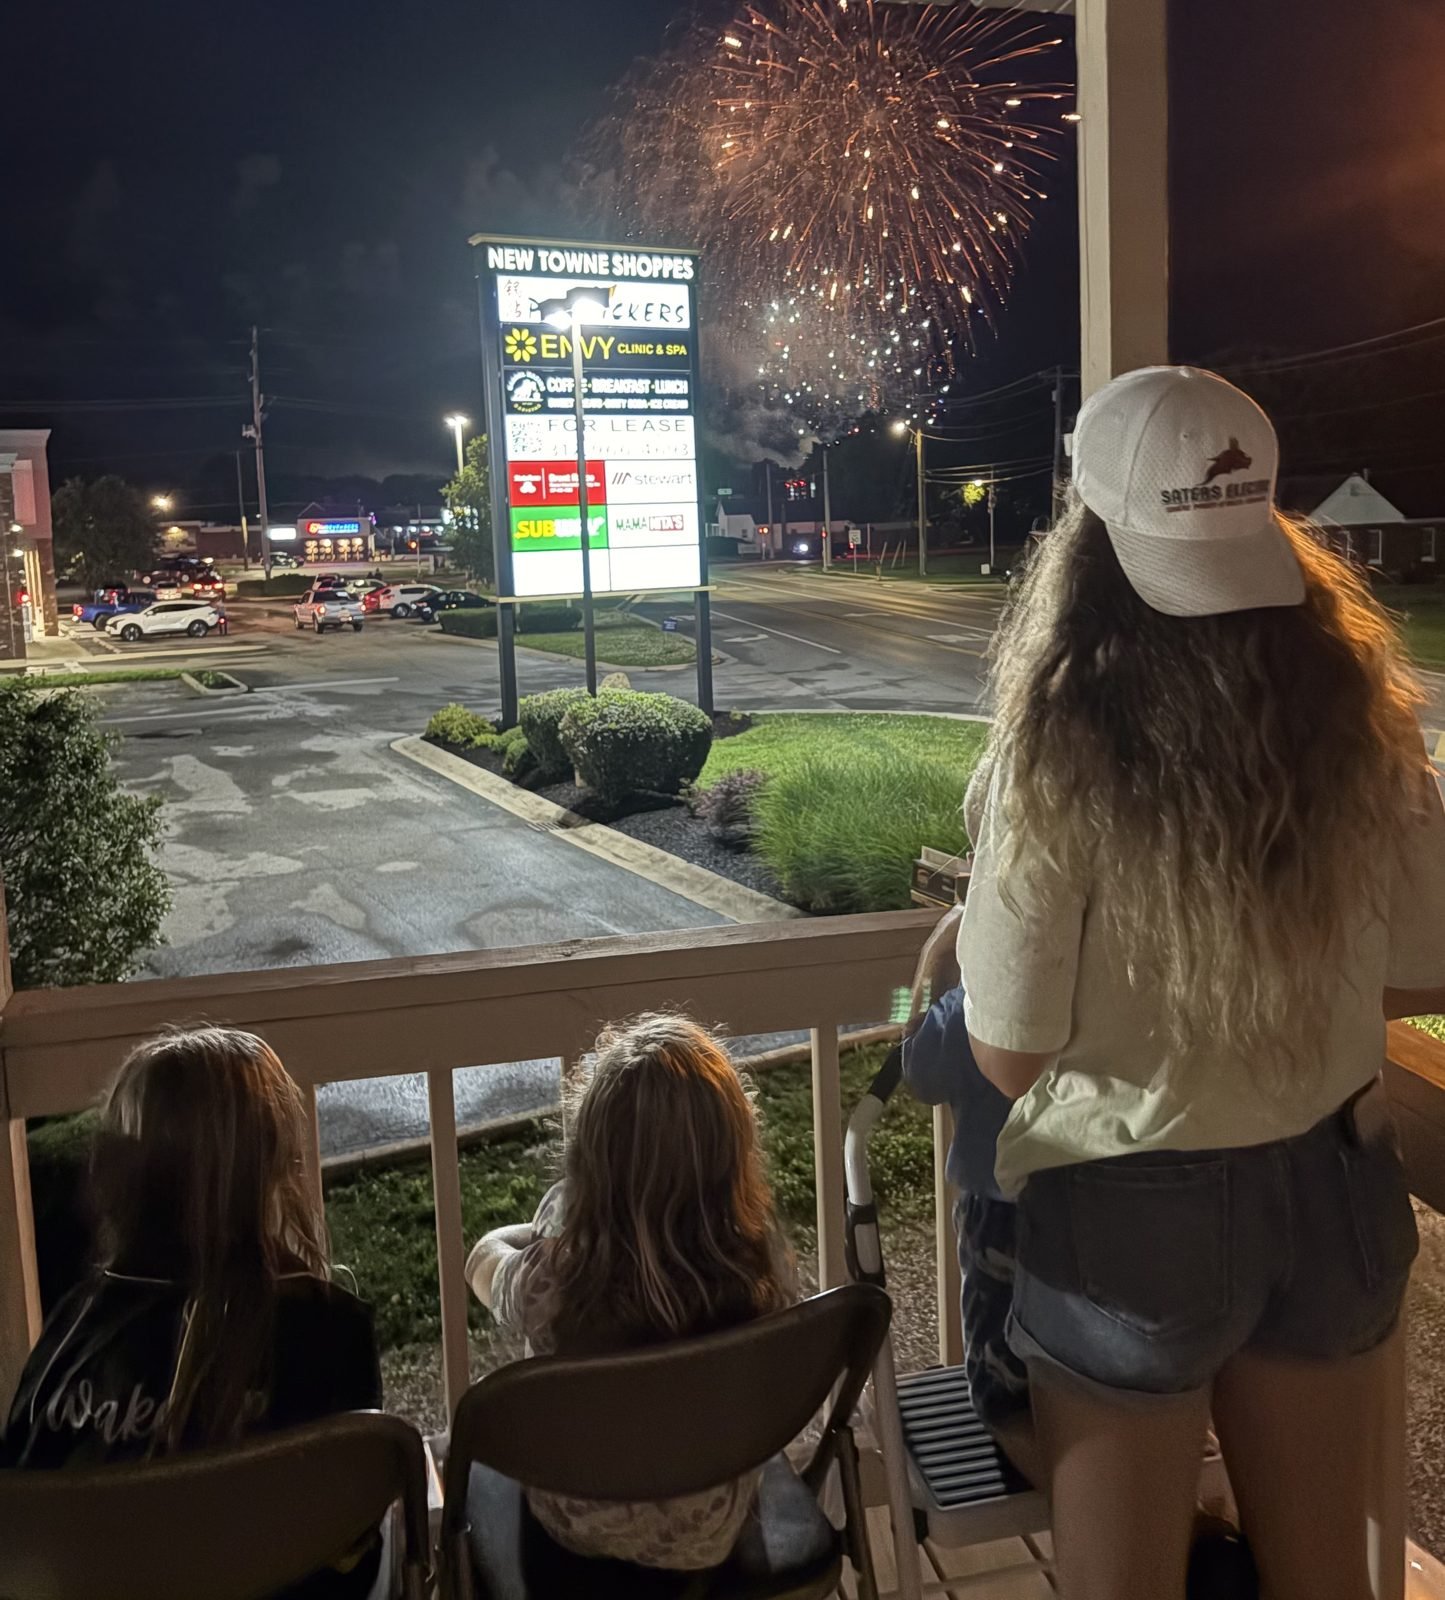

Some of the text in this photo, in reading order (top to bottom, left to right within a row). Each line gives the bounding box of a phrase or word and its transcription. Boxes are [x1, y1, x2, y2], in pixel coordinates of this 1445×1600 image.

[488, 247, 694, 280] NEW TOWNE SHOPPES
[617, 343, 653, 355] CLINIC
[656, 344, 664, 355] &
[666, 345, 687, 355] SPA
[592, 379, 650, 393] BREAKFAST
[655, 380, 688, 394] LUNCH
[548, 419, 687, 432] FOR LEASE
[634, 473, 692, 485] stewart
[1161, 485, 1222, 505] SATERS
[615, 516, 648, 531] MAMA
